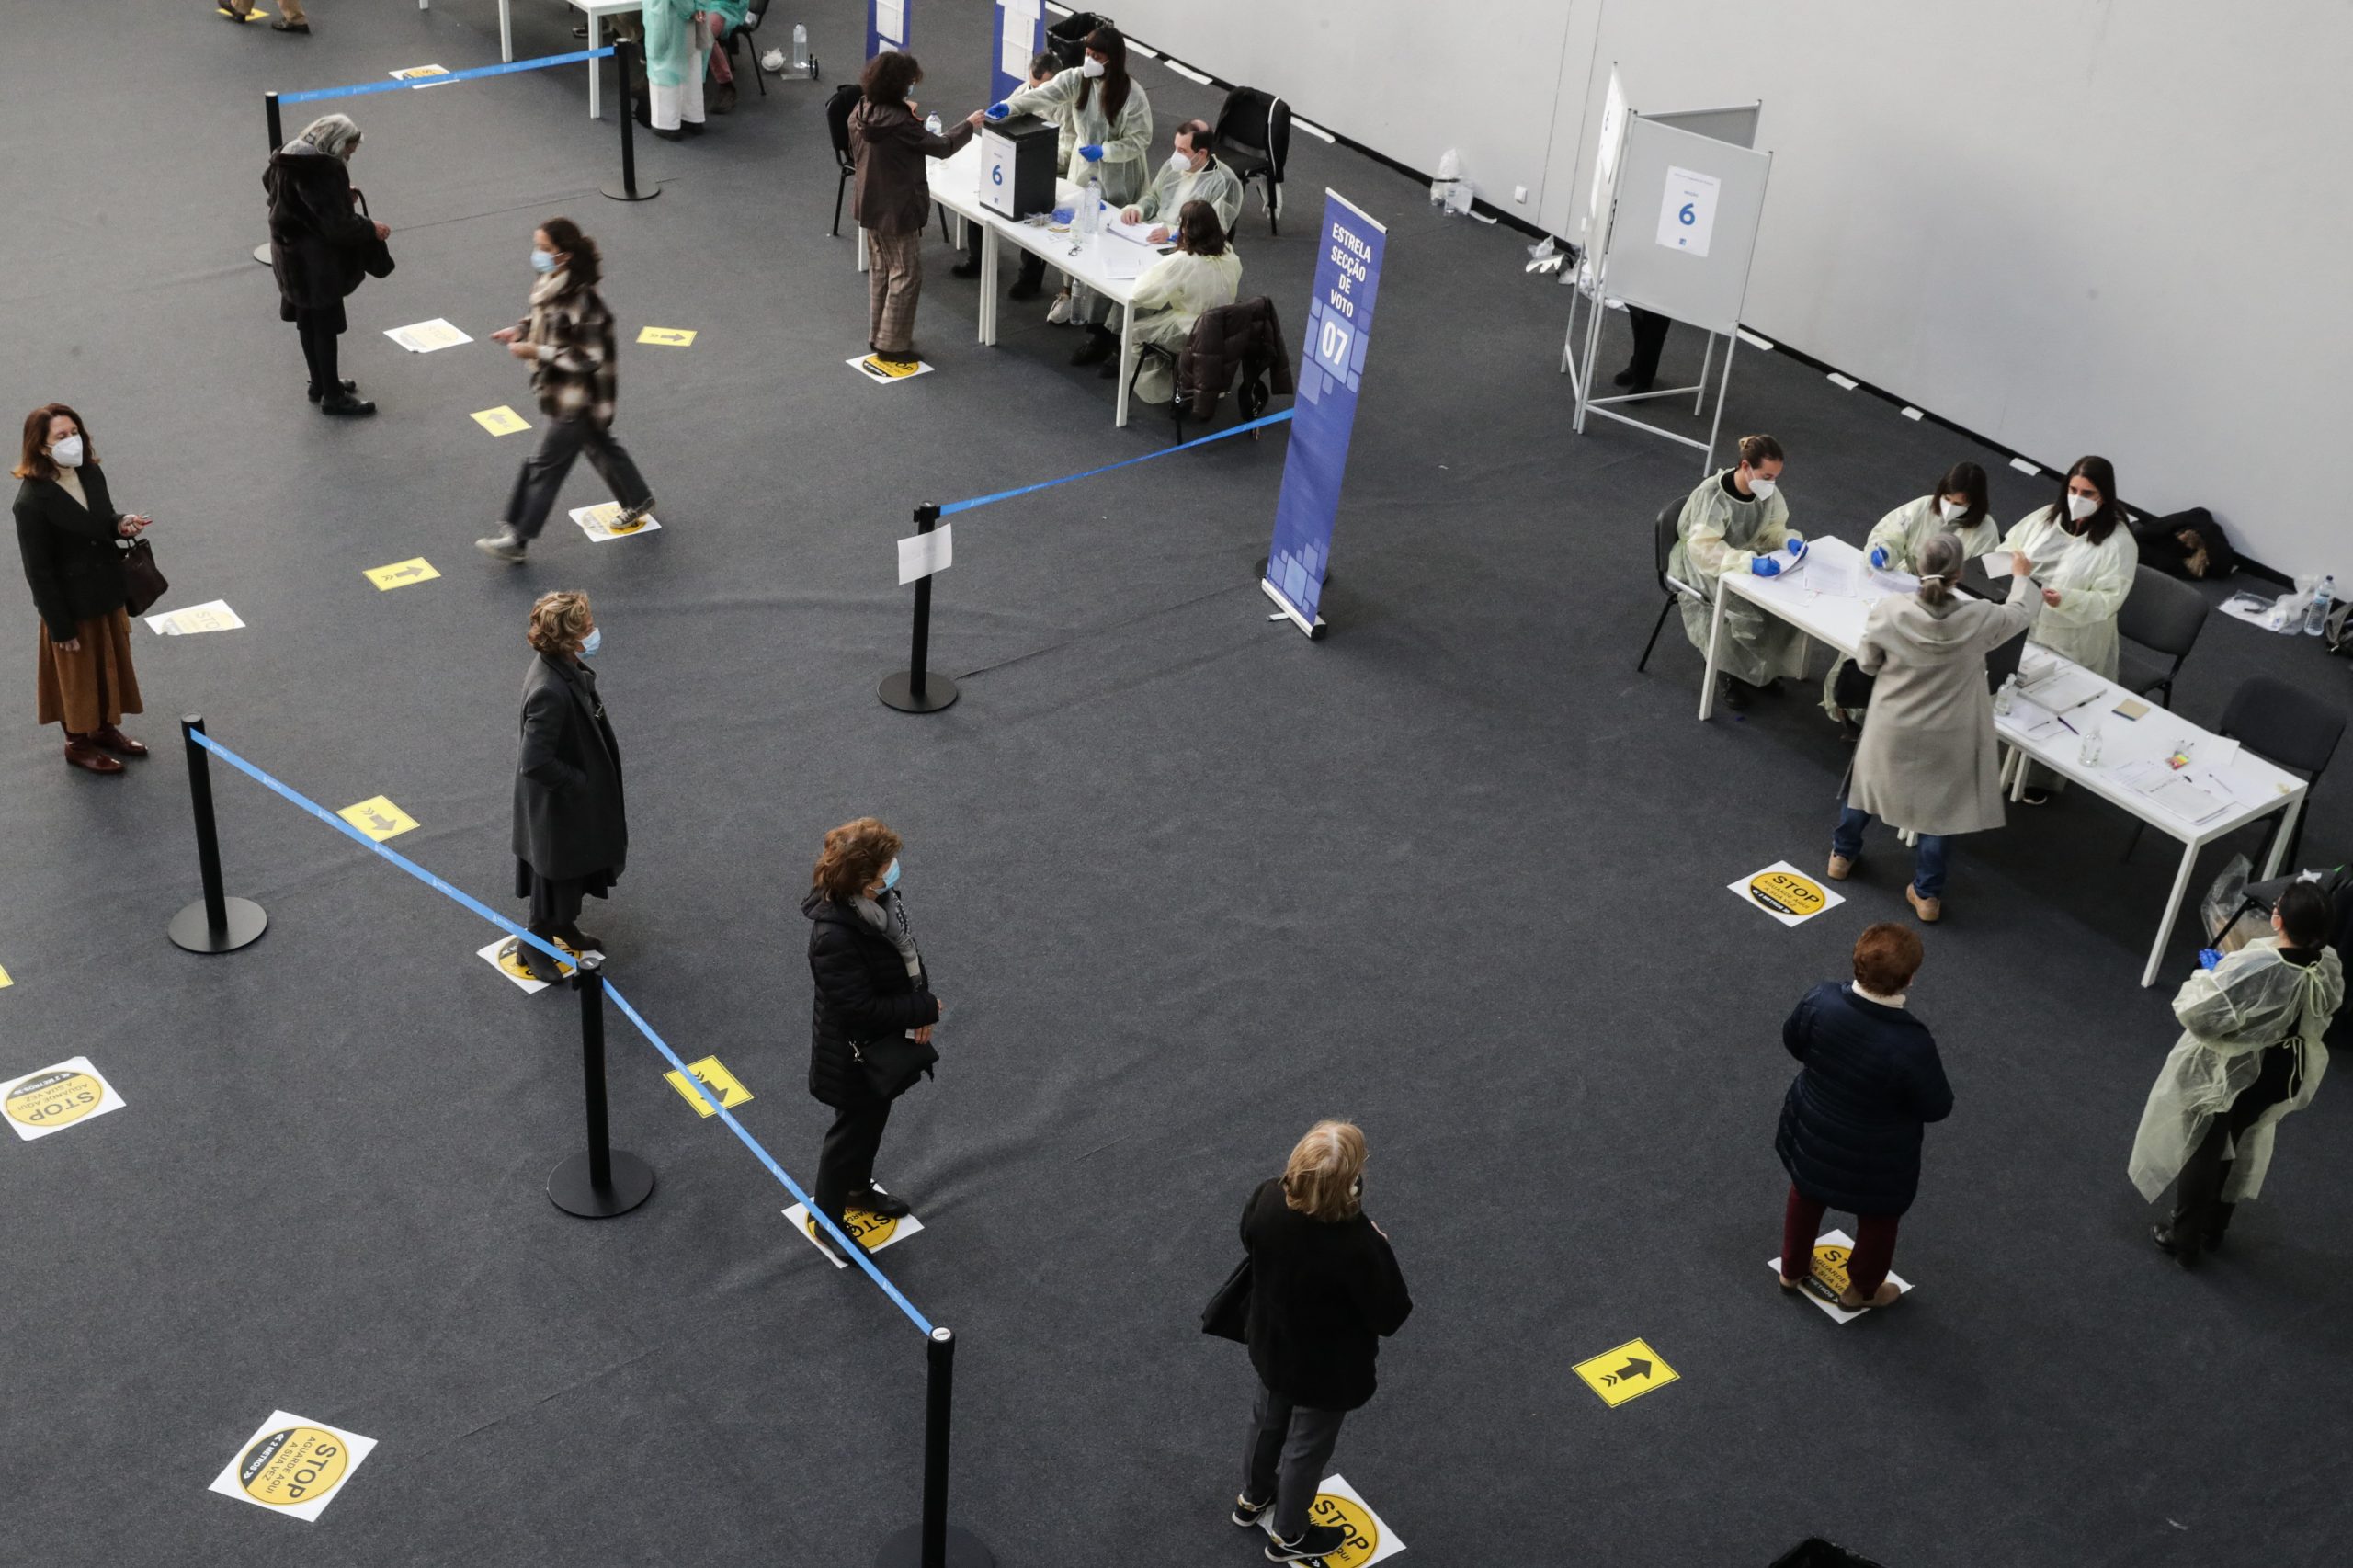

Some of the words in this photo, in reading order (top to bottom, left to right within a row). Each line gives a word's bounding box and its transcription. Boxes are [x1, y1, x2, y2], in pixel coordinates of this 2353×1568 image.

[992, 164, 1003, 186] 6
[1679, 202, 1696, 226] 6
[1332, 222, 1371, 264] ESTRELA
[1331, 245, 1367, 282] SECÇÃO
[1338, 274, 1352, 295] DE
[1330, 289, 1354, 318] VOTO
[1322, 320, 1349, 366] 07
[1772, 875, 1820, 903] STOP
[24, 1077, 54, 1091] METROS
[44, 1083, 88, 1103] AGUARDE
[29, 1091, 95, 1121] STOP
[249, 1446, 275, 1471] METROS
[275, 1449, 293, 1464] SUA
[284, 1436, 316, 1474] AGUARDE
[262, 1465, 281, 1482] VEZ
[266, 1473, 285, 1494] AQUI
[287, 1443, 337, 1499] STOP
[1314, 1499, 1369, 1550] STOP
